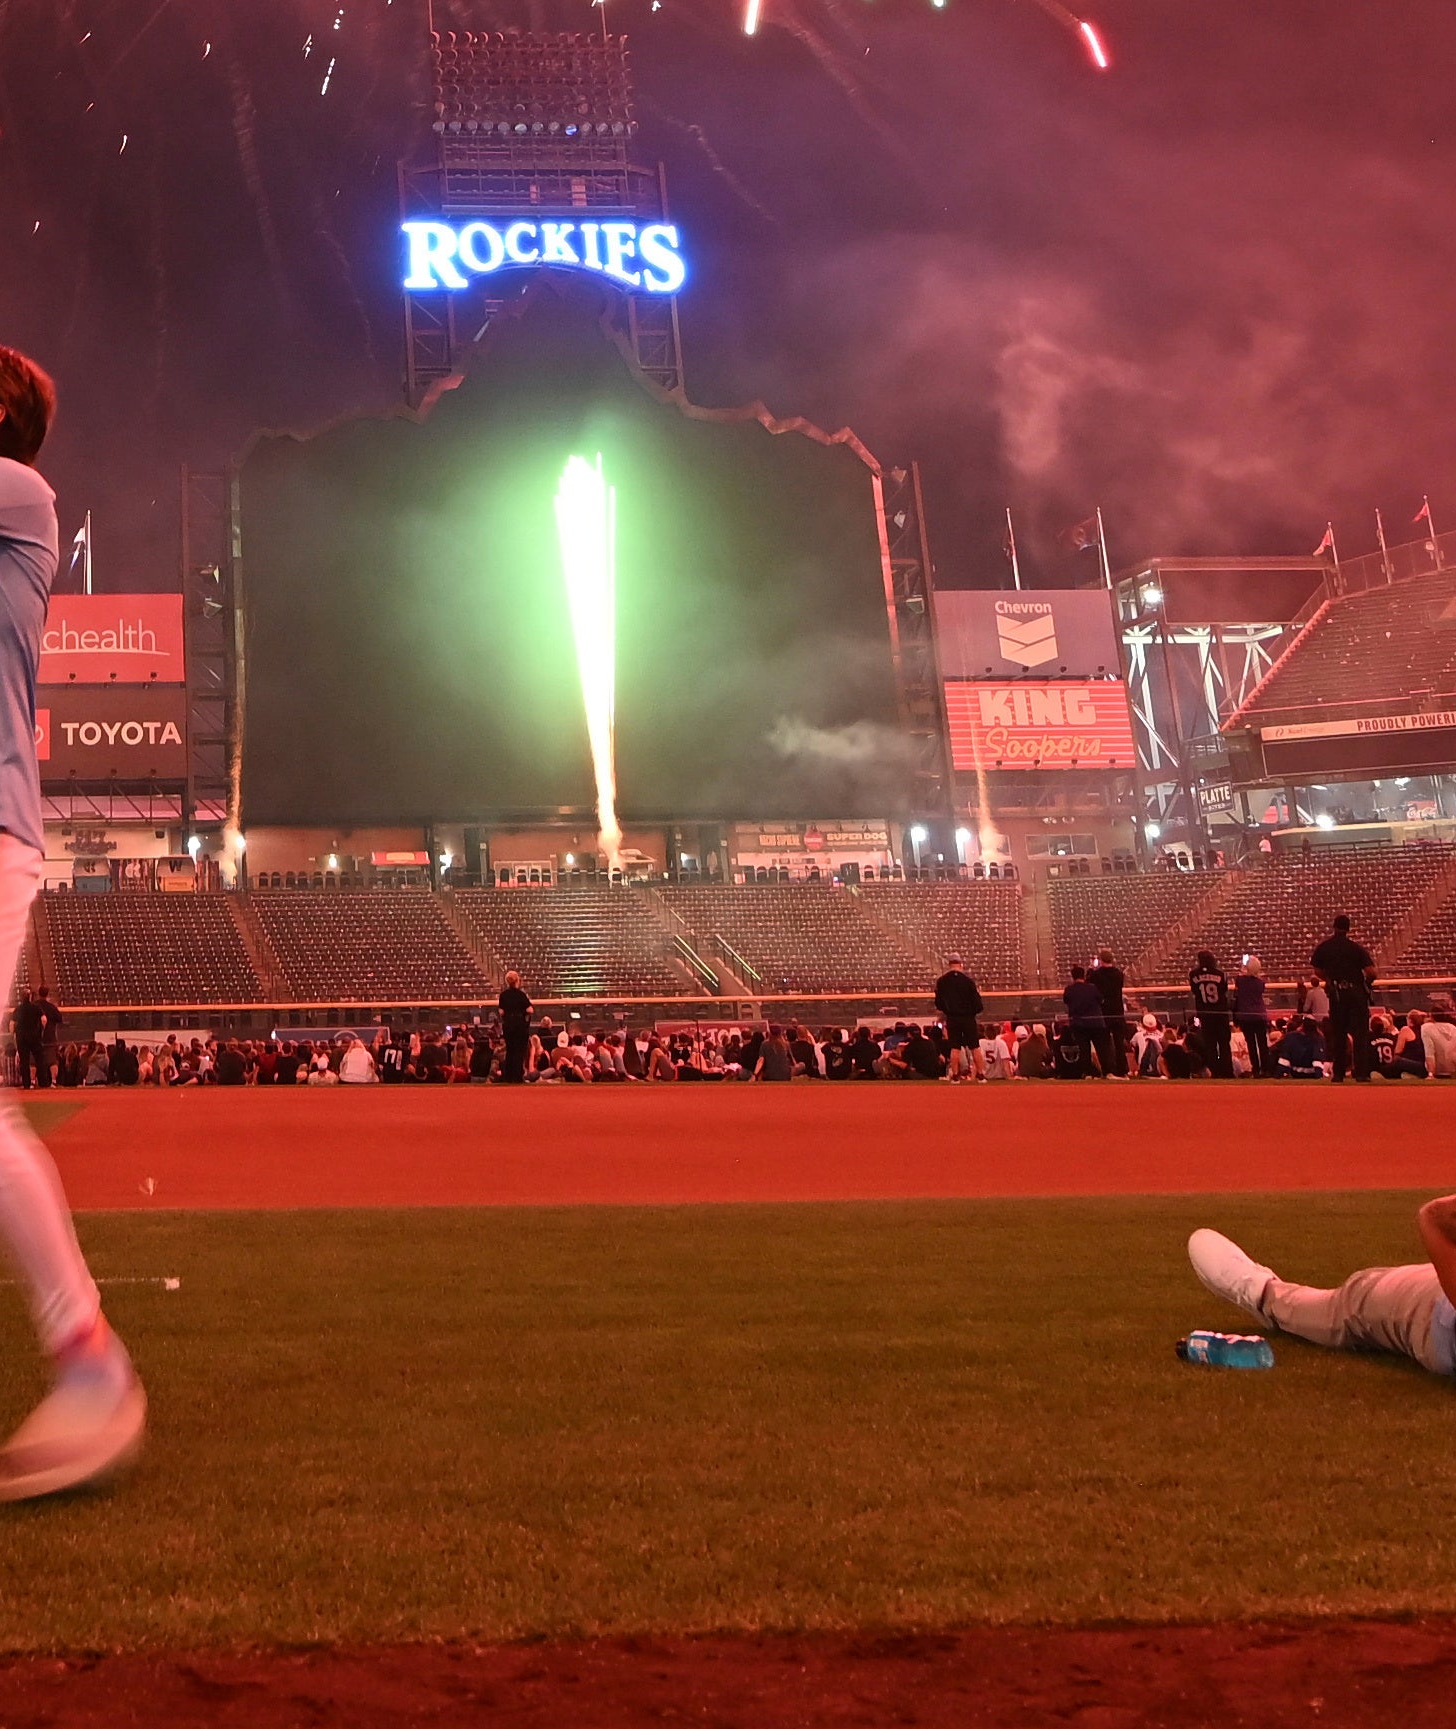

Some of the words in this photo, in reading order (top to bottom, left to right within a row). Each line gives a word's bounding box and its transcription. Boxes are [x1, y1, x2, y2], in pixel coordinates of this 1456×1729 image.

[402, 221, 686, 292] ROCKIES
[994, 600, 1052, 614] Chevron
[41, 618, 157, 653] chealth
[978, 689, 1097, 726] KING
[60, 720, 182, 746] TOYOTA
[1356, 715, 1407, 732] PROUDLY
[985, 727, 1102, 766] Soopers
[1200, 785, 1231, 806] PLATTE
[826, 832, 863, 841] SUPER
[864, 831, 887, 841] DOG
[1198, 982, 1219, 1004] 19
[1377, 1045, 1393, 1063] 19
